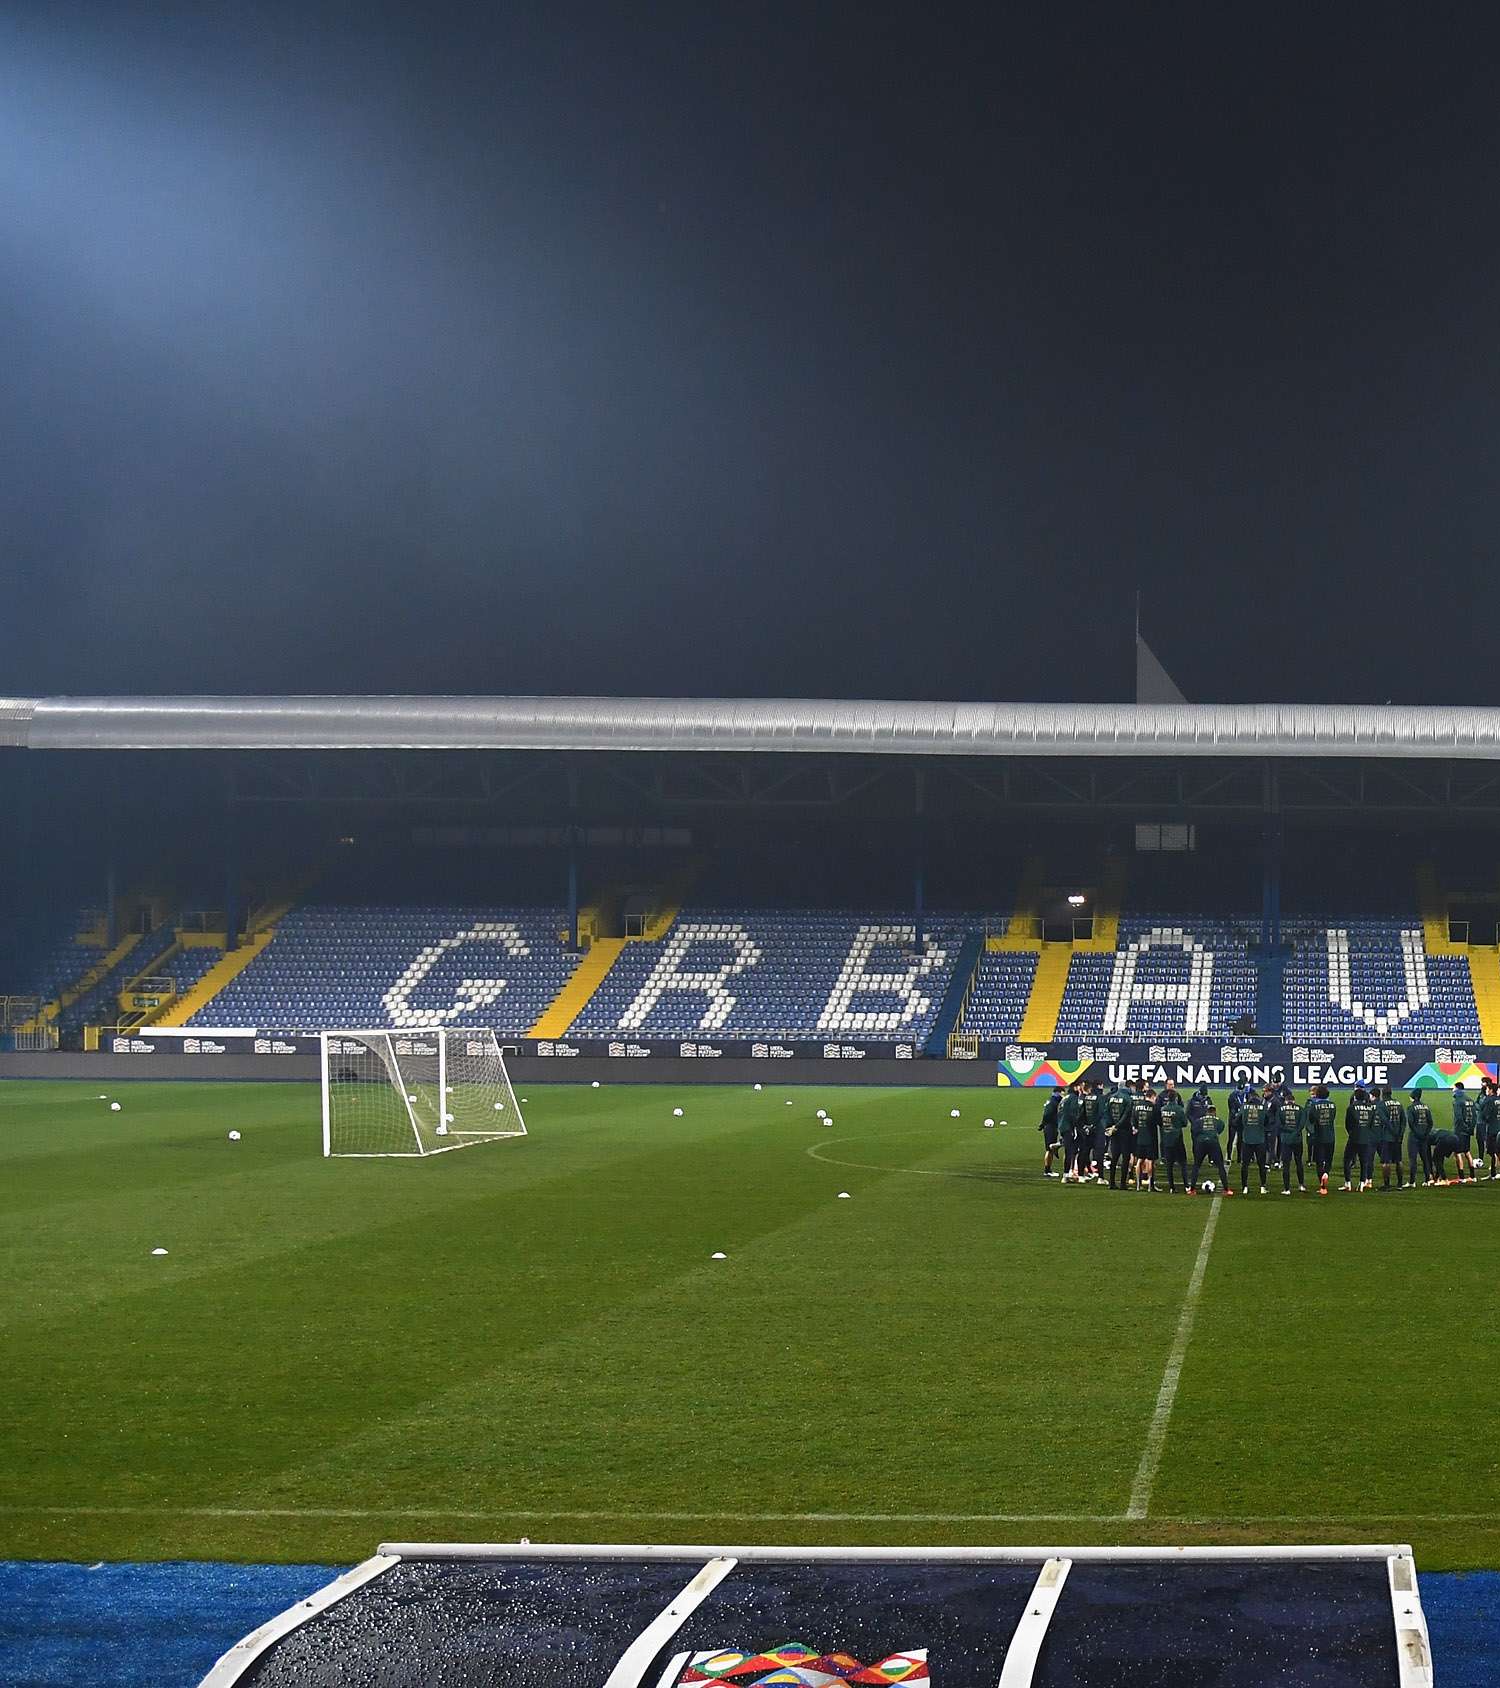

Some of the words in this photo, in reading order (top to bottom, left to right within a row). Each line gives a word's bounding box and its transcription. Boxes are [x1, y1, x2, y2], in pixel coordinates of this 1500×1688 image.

[1108, 1064, 1168, 1083] UEFA
[1176, 1065, 1286, 1084] NATIONS
[1294, 1066, 1388, 1084] LEAGUE
